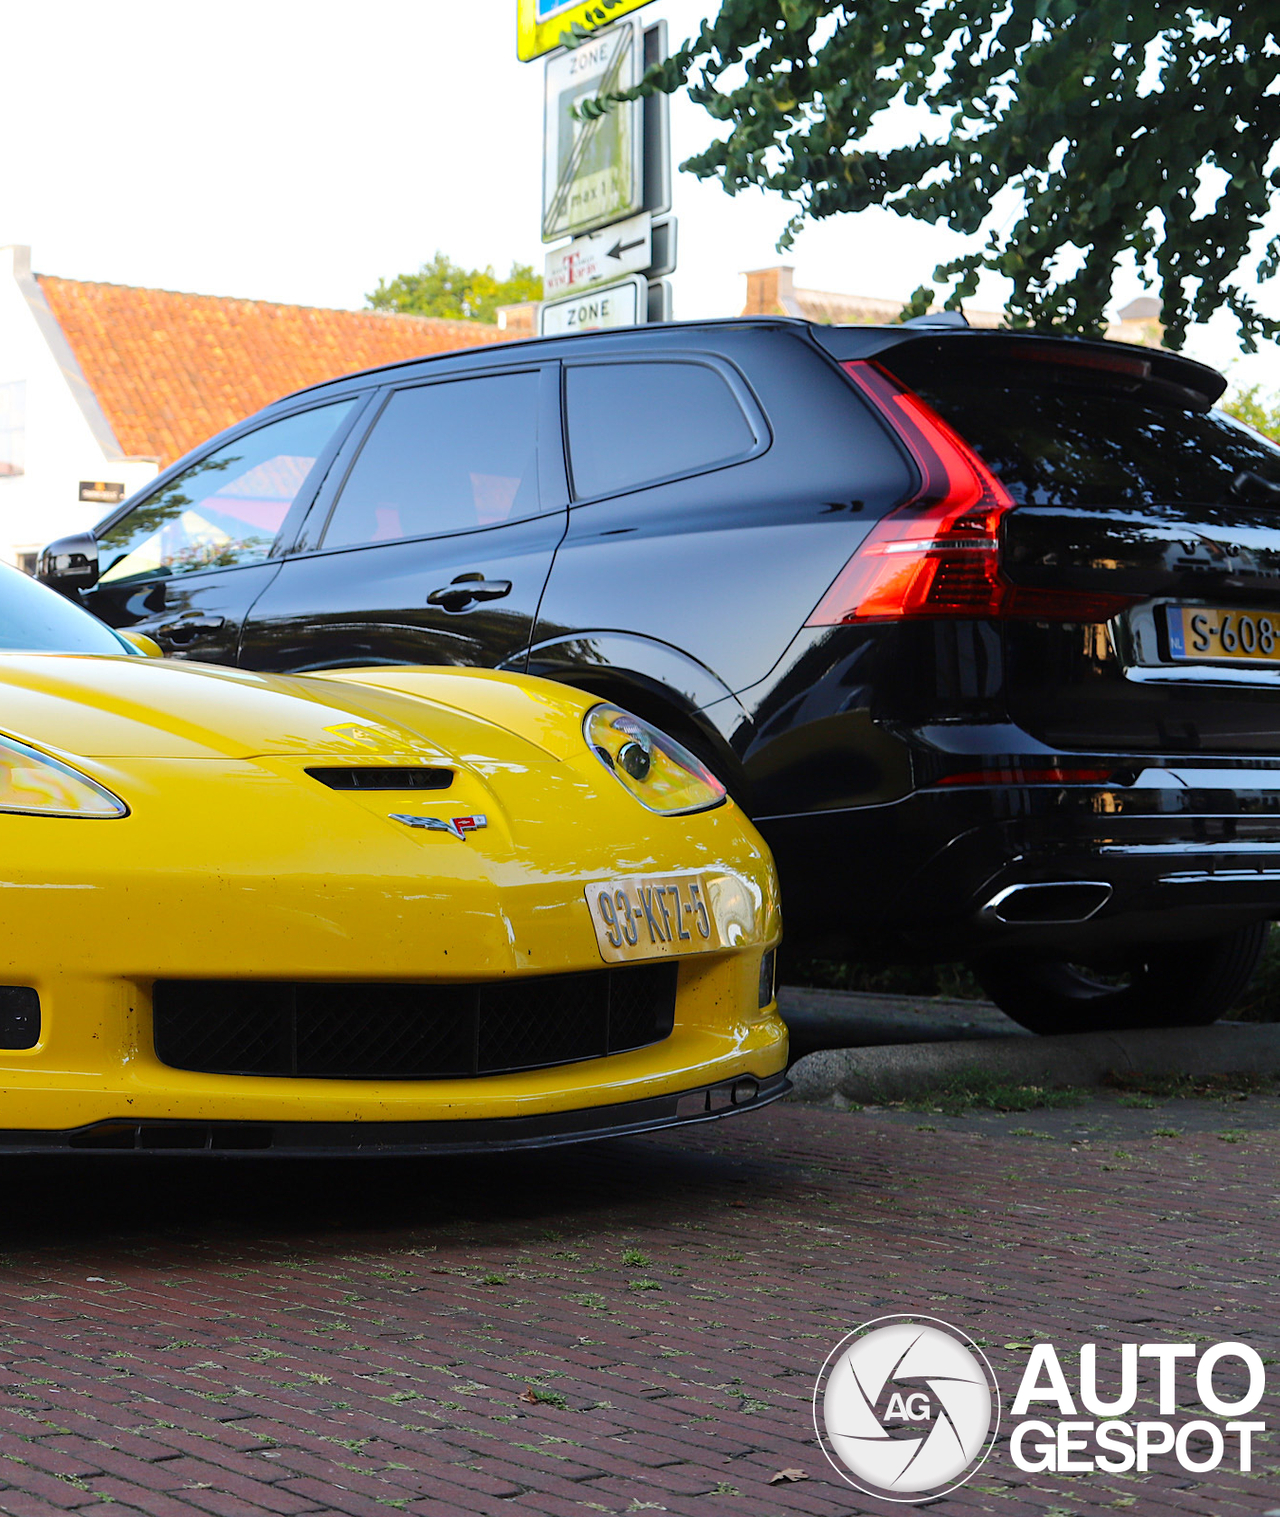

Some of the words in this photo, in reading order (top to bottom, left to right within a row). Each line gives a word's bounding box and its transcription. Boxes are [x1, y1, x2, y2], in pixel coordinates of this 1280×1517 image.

[570, 42, 609, 75] ZONE
[567, 299, 609, 326] ZONE
[1170, 637, 1183, 650] NL
[598, 884, 711, 948] 93-KFZ-5
